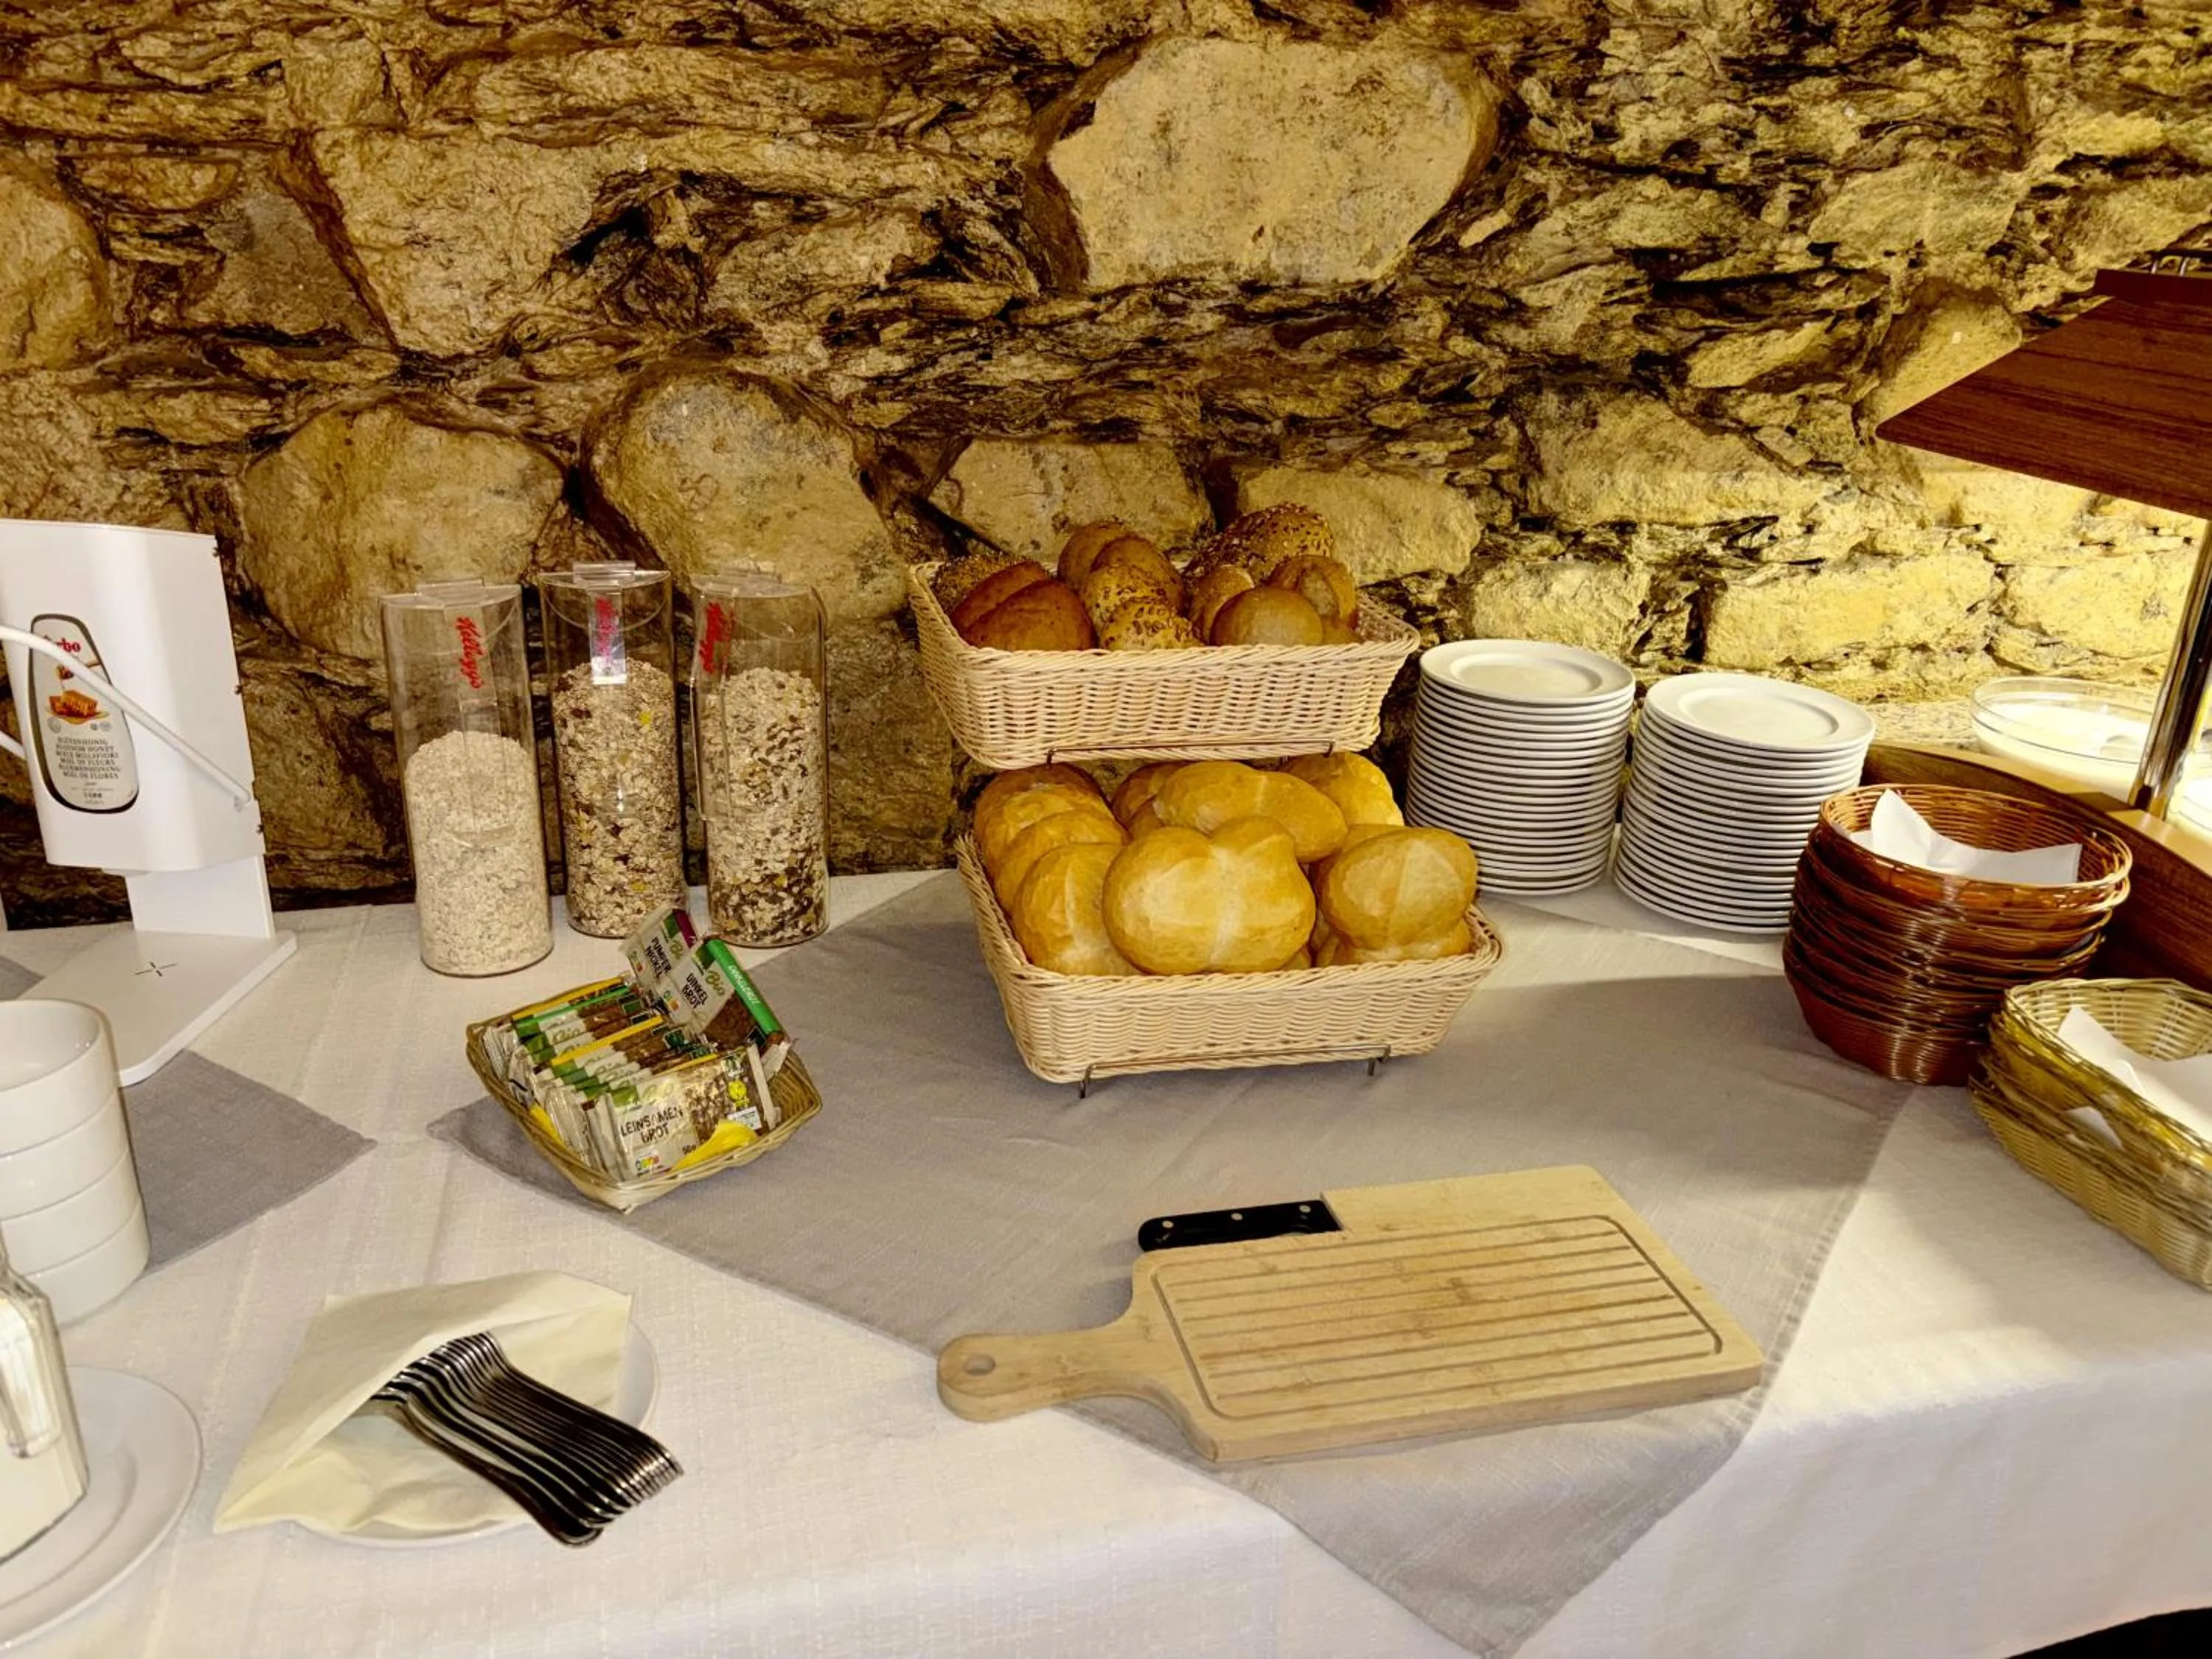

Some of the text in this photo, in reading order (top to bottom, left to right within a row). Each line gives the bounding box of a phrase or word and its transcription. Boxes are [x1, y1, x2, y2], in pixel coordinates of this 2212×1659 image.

[456, 617, 484, 689] Kellogg's
[650, 937, 672, 974] PUMPER
[681, 984, 701, 1009] BROT
[705, 970, 726, 996] Bio
[620, 1105, 684, 1138] LEINSAMEN
[641, 1121, 669, 1144] BROT
